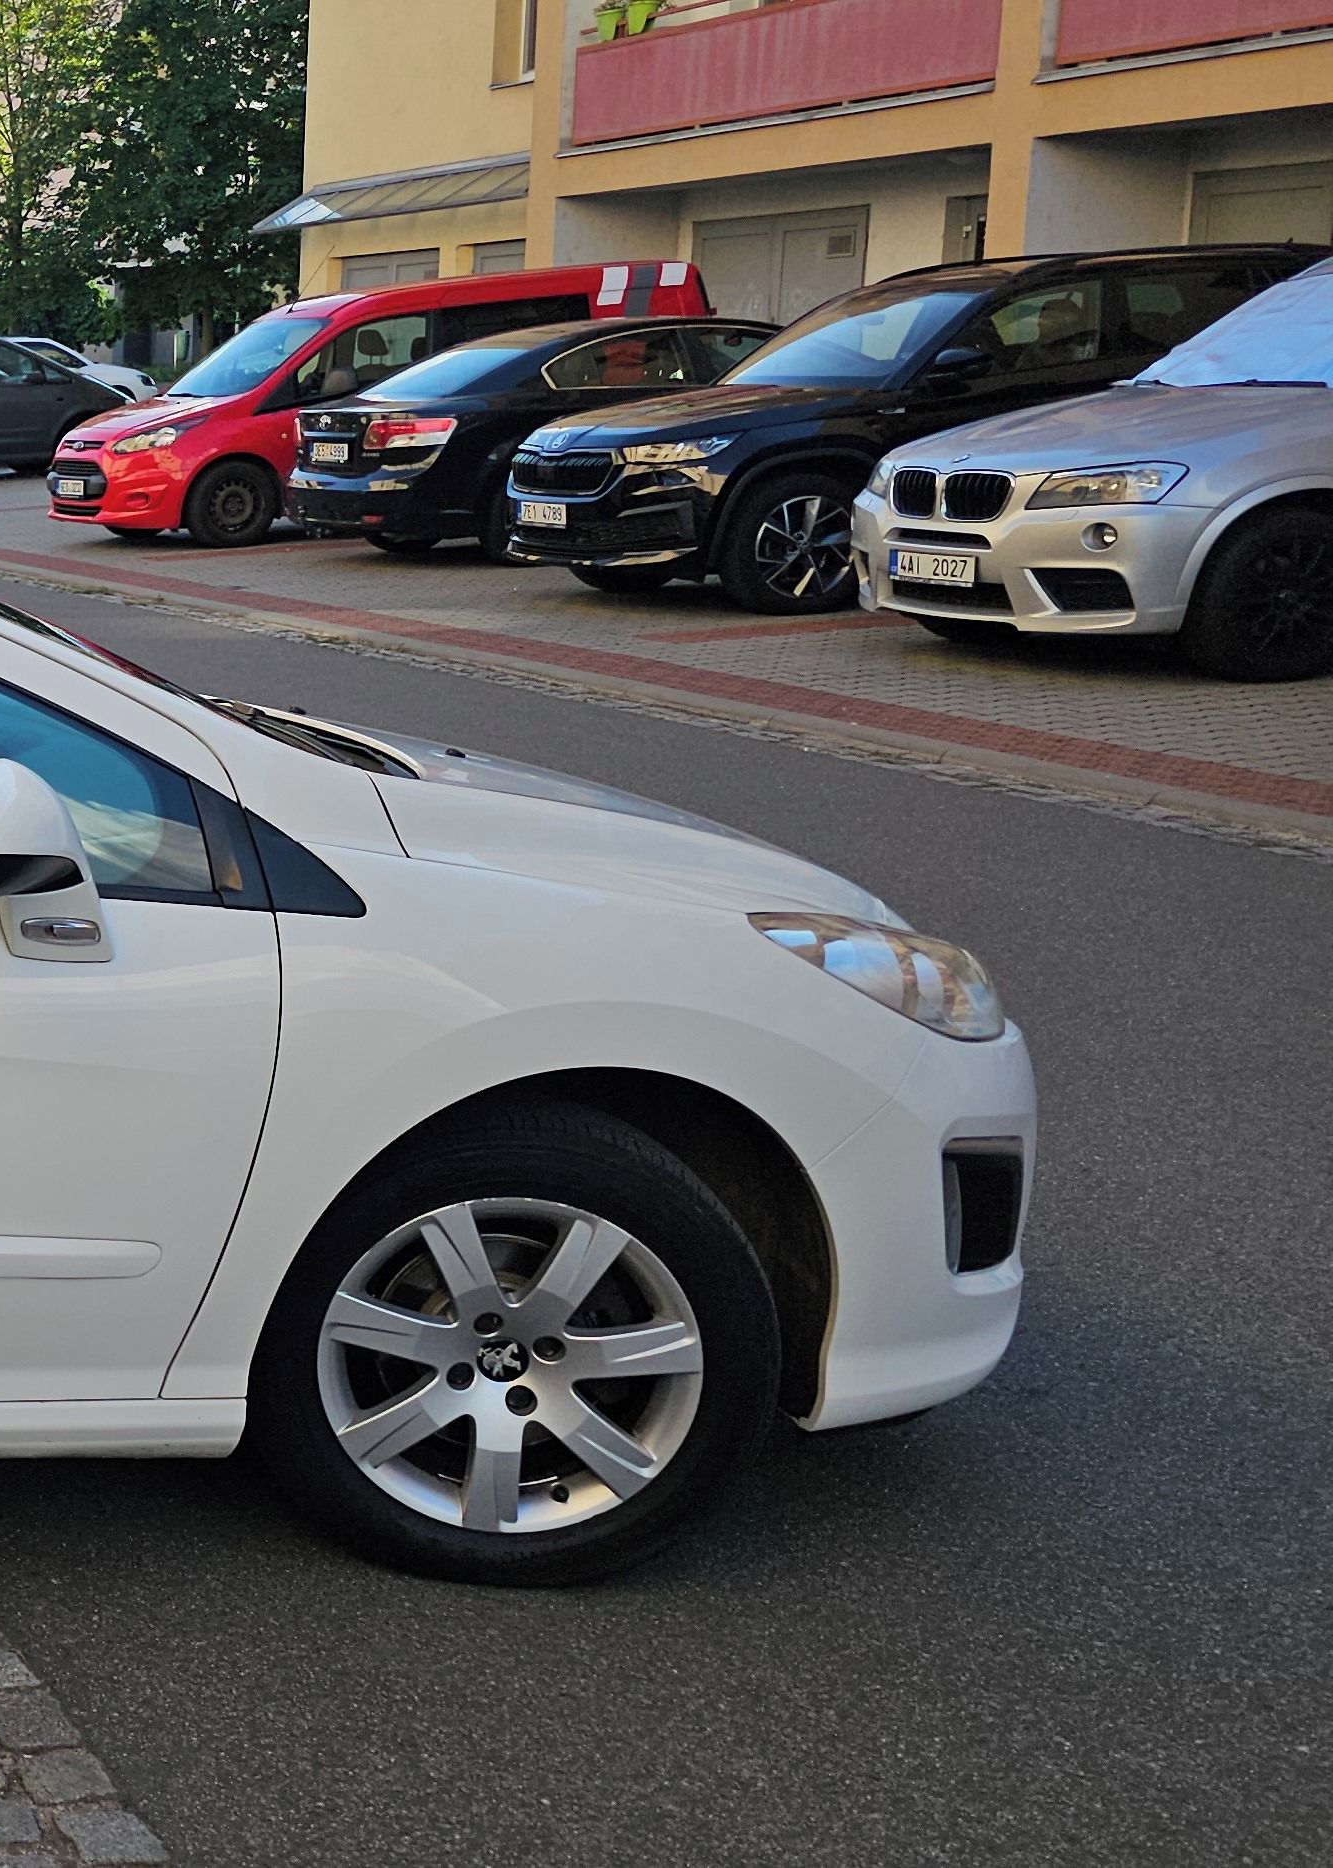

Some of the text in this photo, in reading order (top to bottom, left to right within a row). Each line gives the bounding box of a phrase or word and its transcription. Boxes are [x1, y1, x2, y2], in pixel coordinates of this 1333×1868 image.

[523, 503, 562, 521] 7E1 4789
[933, 558, 968, 578] 2027
